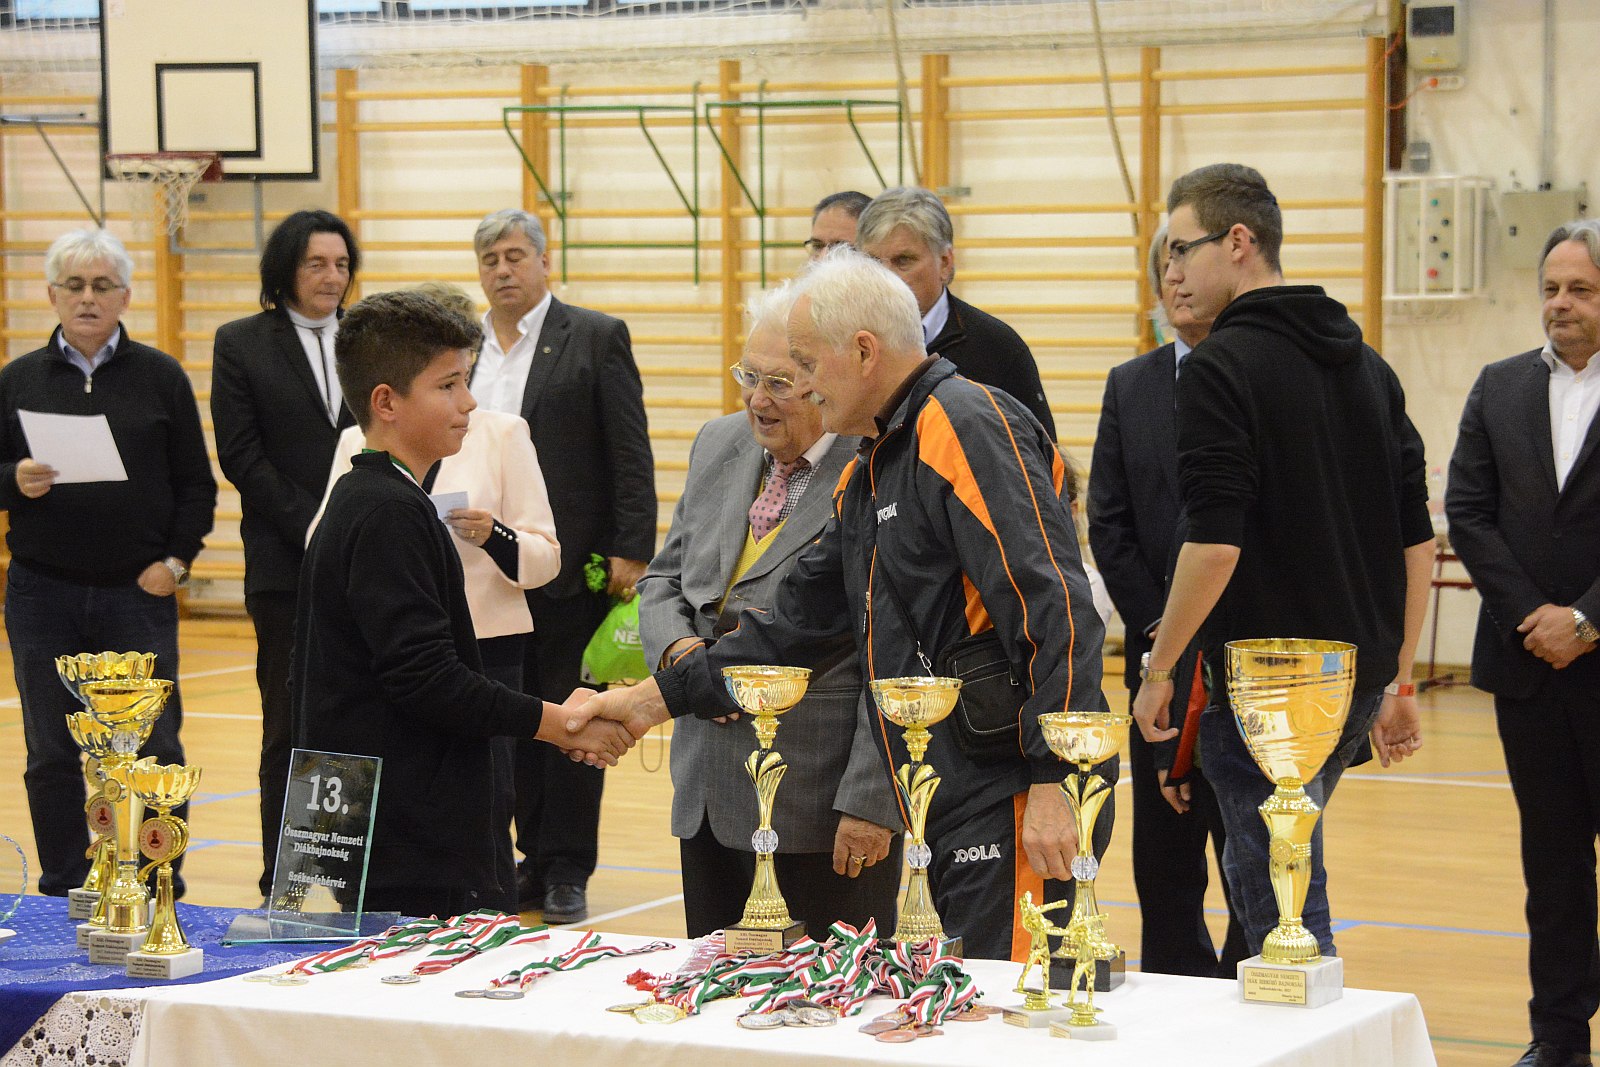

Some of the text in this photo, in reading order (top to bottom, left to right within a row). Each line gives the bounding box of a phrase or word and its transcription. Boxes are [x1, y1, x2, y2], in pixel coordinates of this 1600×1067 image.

[306, 774, 349, 815] 13.
[284, 825, 364, 847] Összmagyar Nemzeti
[293, 843, 349, 861] Diákbajnokság
[288, 870, 347, 889] Székesfehérvár
